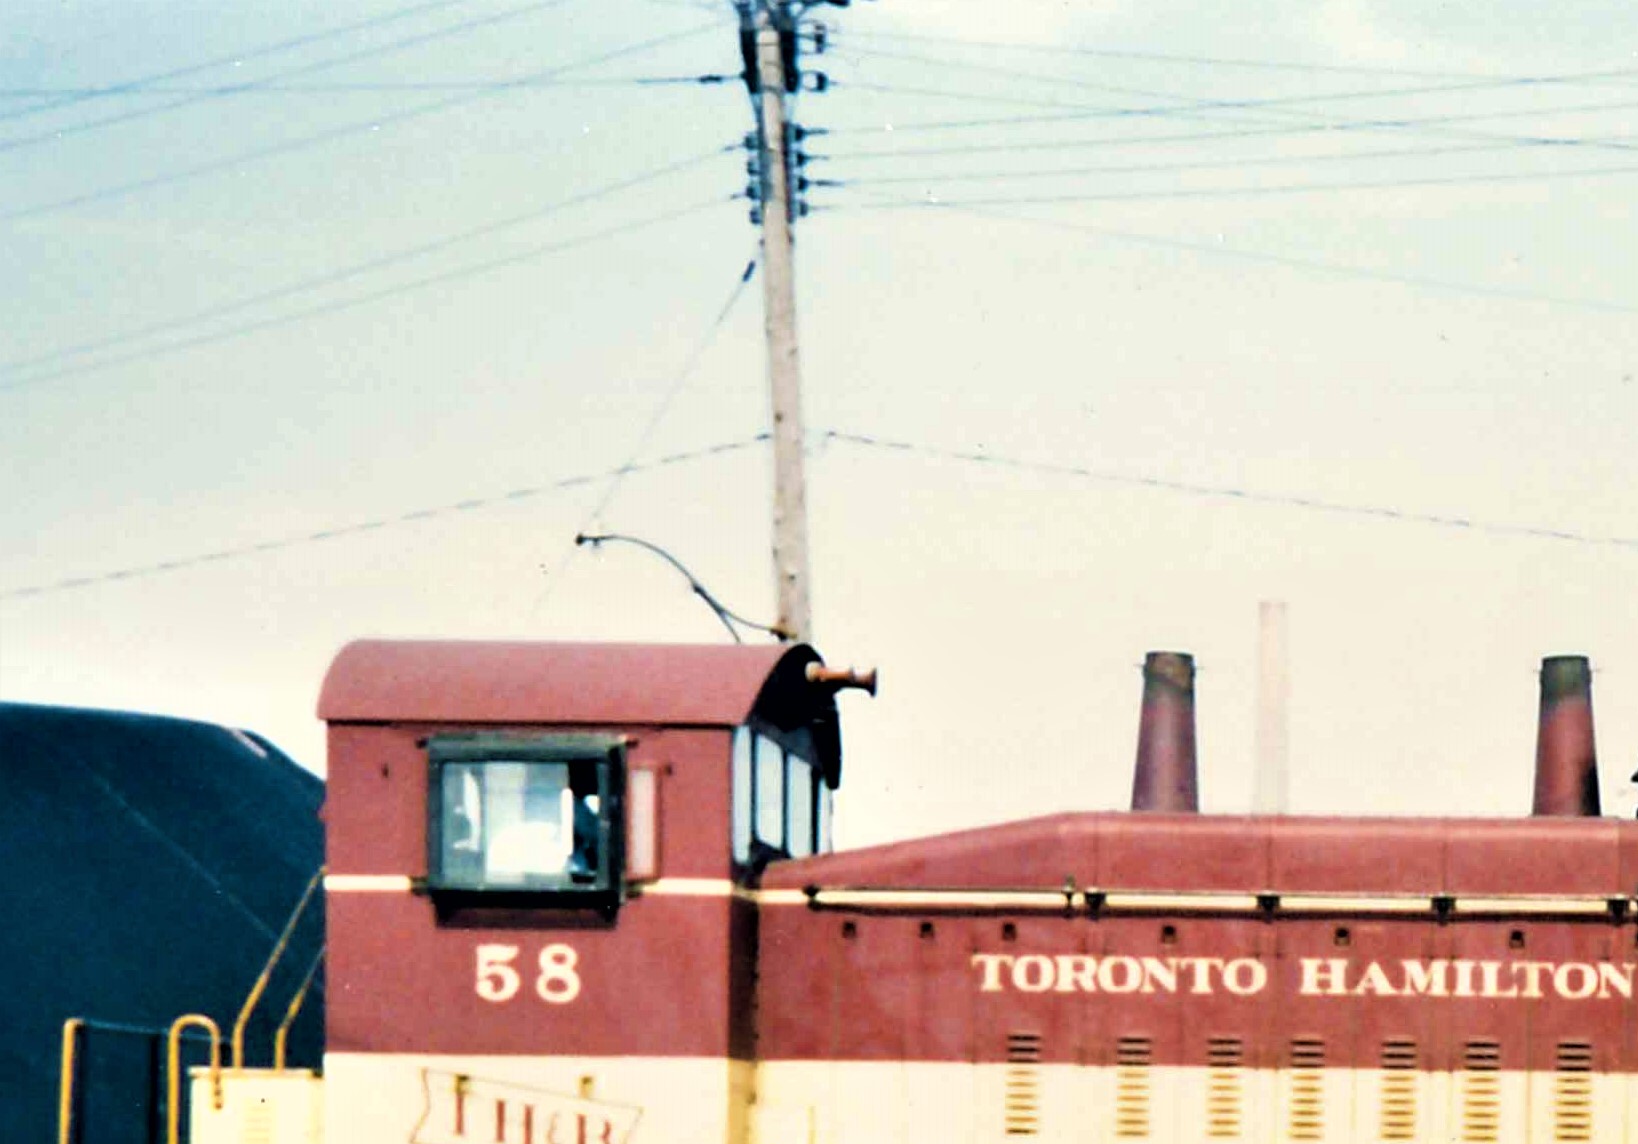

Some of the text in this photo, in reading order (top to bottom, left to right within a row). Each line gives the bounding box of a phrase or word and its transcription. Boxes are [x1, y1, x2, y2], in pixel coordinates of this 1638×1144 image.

[475, 943, 581, 1003] 58
[971, 953, 1268, 996] TORONTO
[1299, 956, 1635, 1000] HAMILTON
